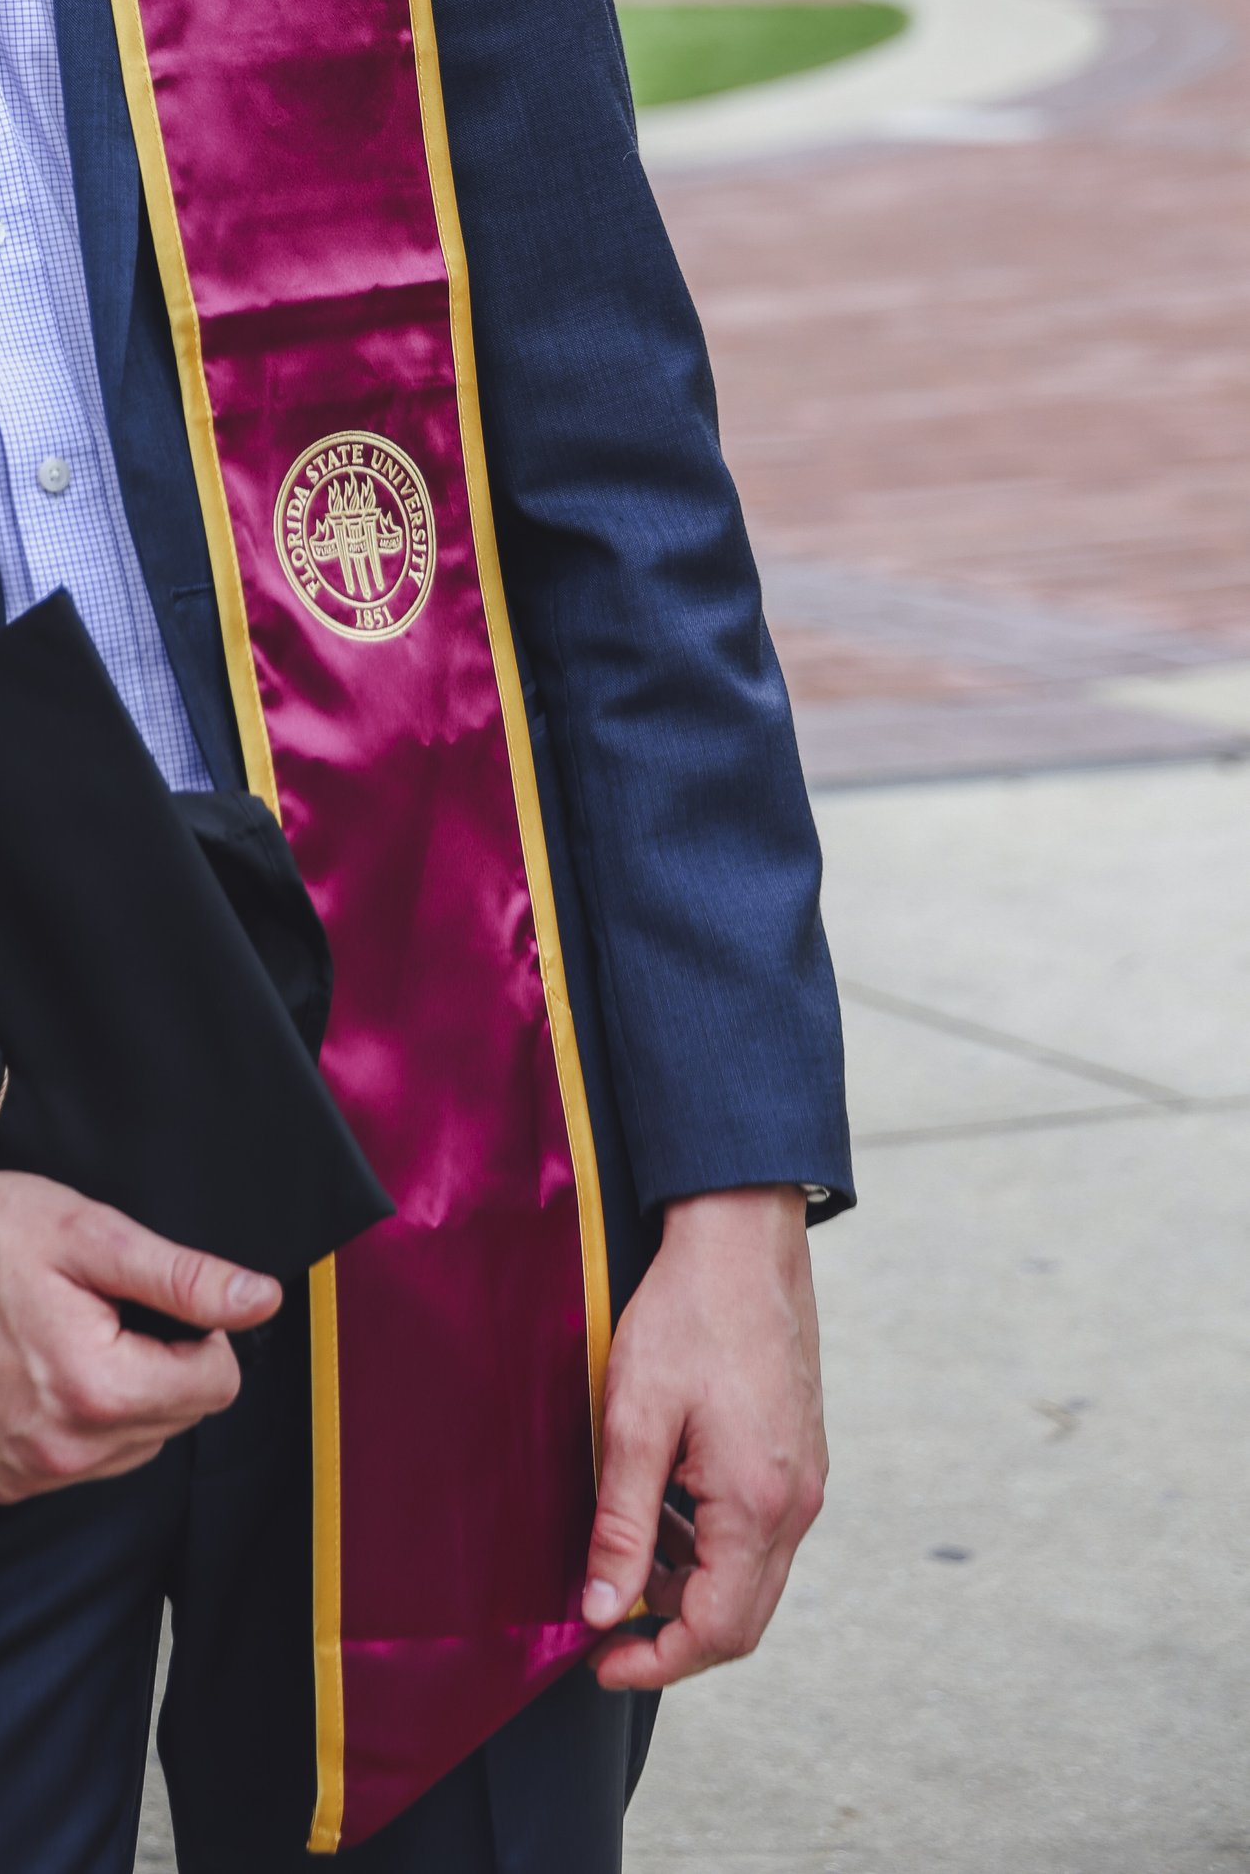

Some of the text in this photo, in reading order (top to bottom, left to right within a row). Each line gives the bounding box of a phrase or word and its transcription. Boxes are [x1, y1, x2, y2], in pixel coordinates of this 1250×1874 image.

[287, 444, 427, 600] FLORIDA STATE UNIVERSITY
[354, 606, 394, 628] 1851
